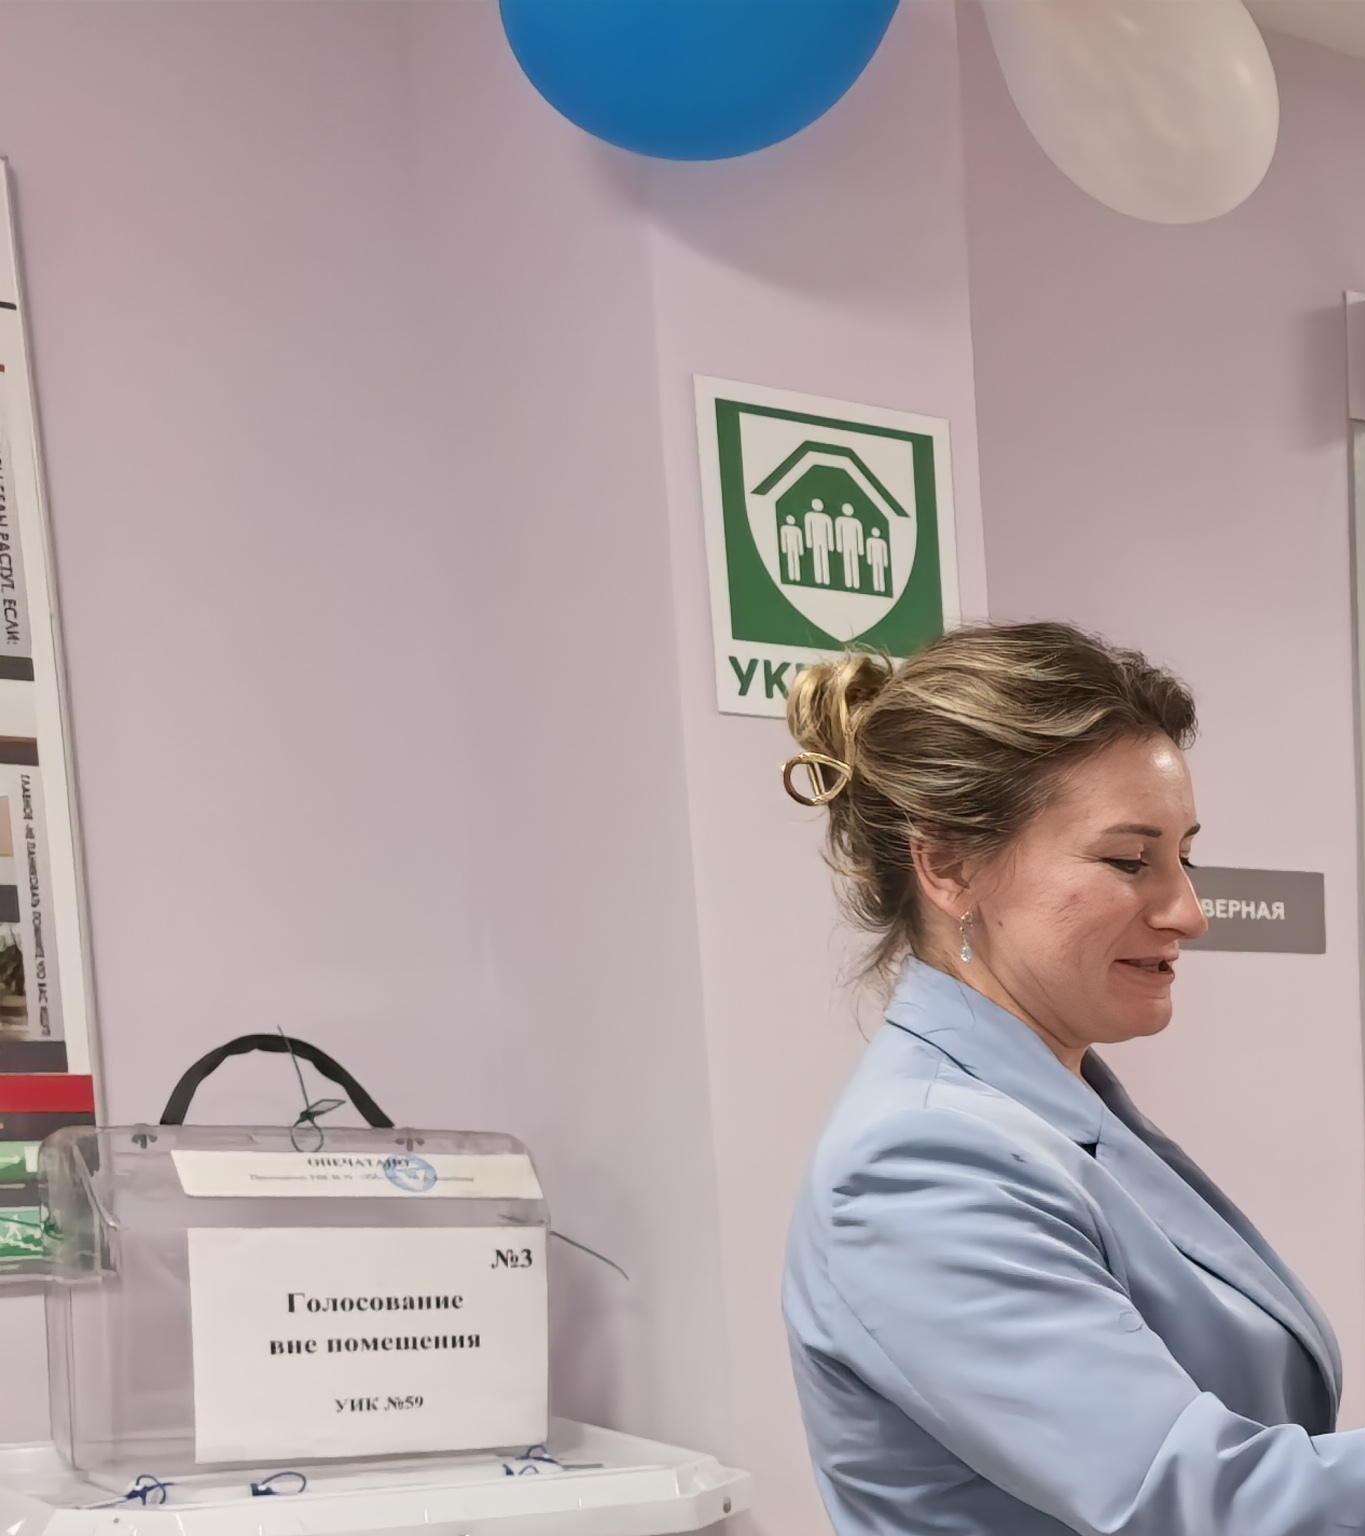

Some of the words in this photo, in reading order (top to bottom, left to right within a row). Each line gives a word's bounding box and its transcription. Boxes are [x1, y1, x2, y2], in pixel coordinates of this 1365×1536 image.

[728, 655, 806, 699] УК
[491, 1248, 533, 1269] №3
[286, 1293, 464, 1313] Голосование
[269, 1339, 317, 1355] вне
[327, 1334, 481, 1353] помещения
[335, 1396, 379, 1413] УИК
[384, 1395, 424, 1411] №59
